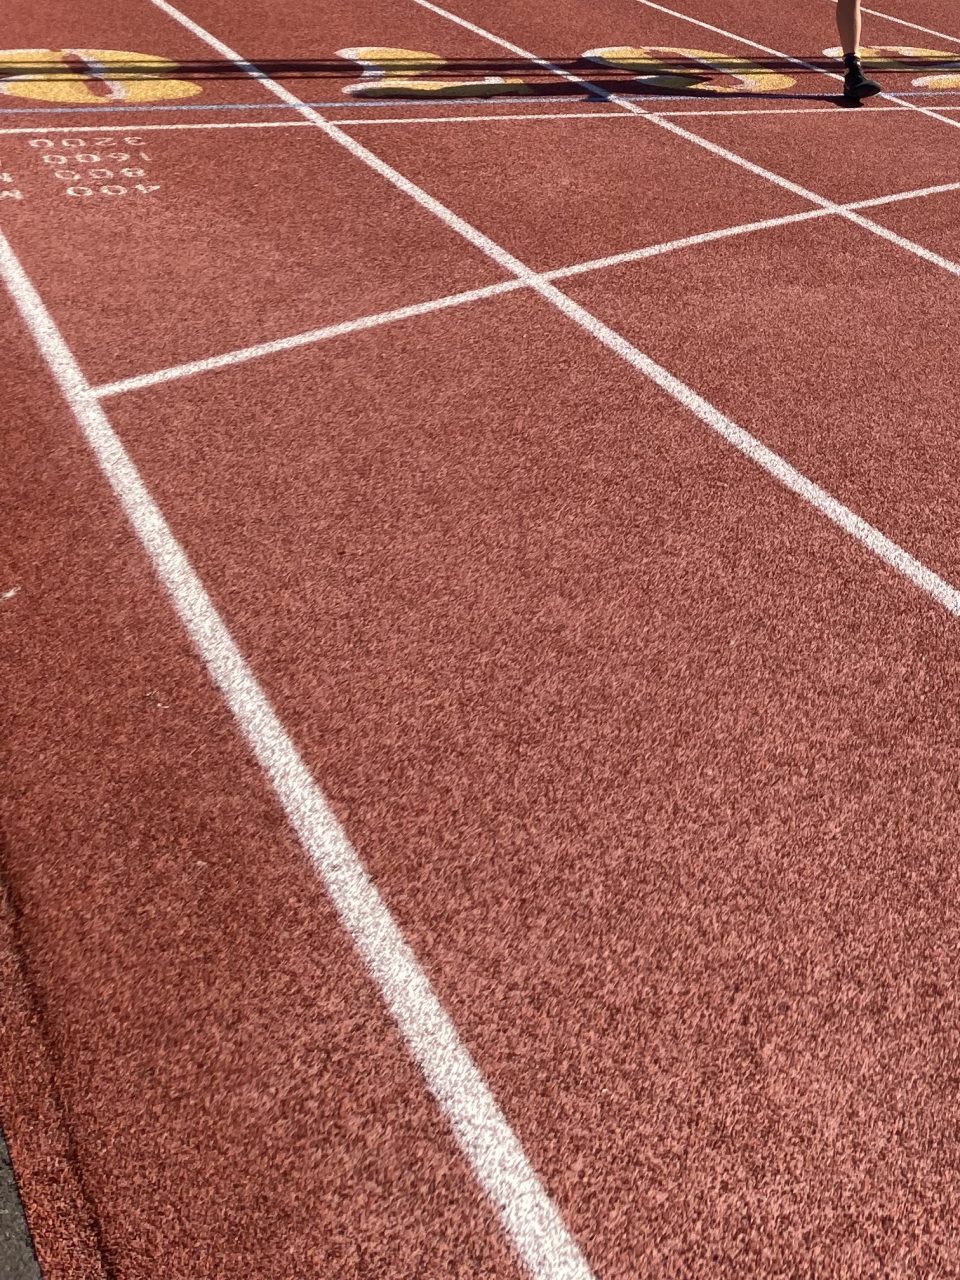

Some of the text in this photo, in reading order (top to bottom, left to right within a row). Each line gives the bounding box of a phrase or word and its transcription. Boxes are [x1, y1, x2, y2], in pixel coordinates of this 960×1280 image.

[29, 136, 147, 148] 3200
[42, 152, 152, 165] 1600
[54, 168, 146, 180] 800
[66, 184, 161, 197] 400
